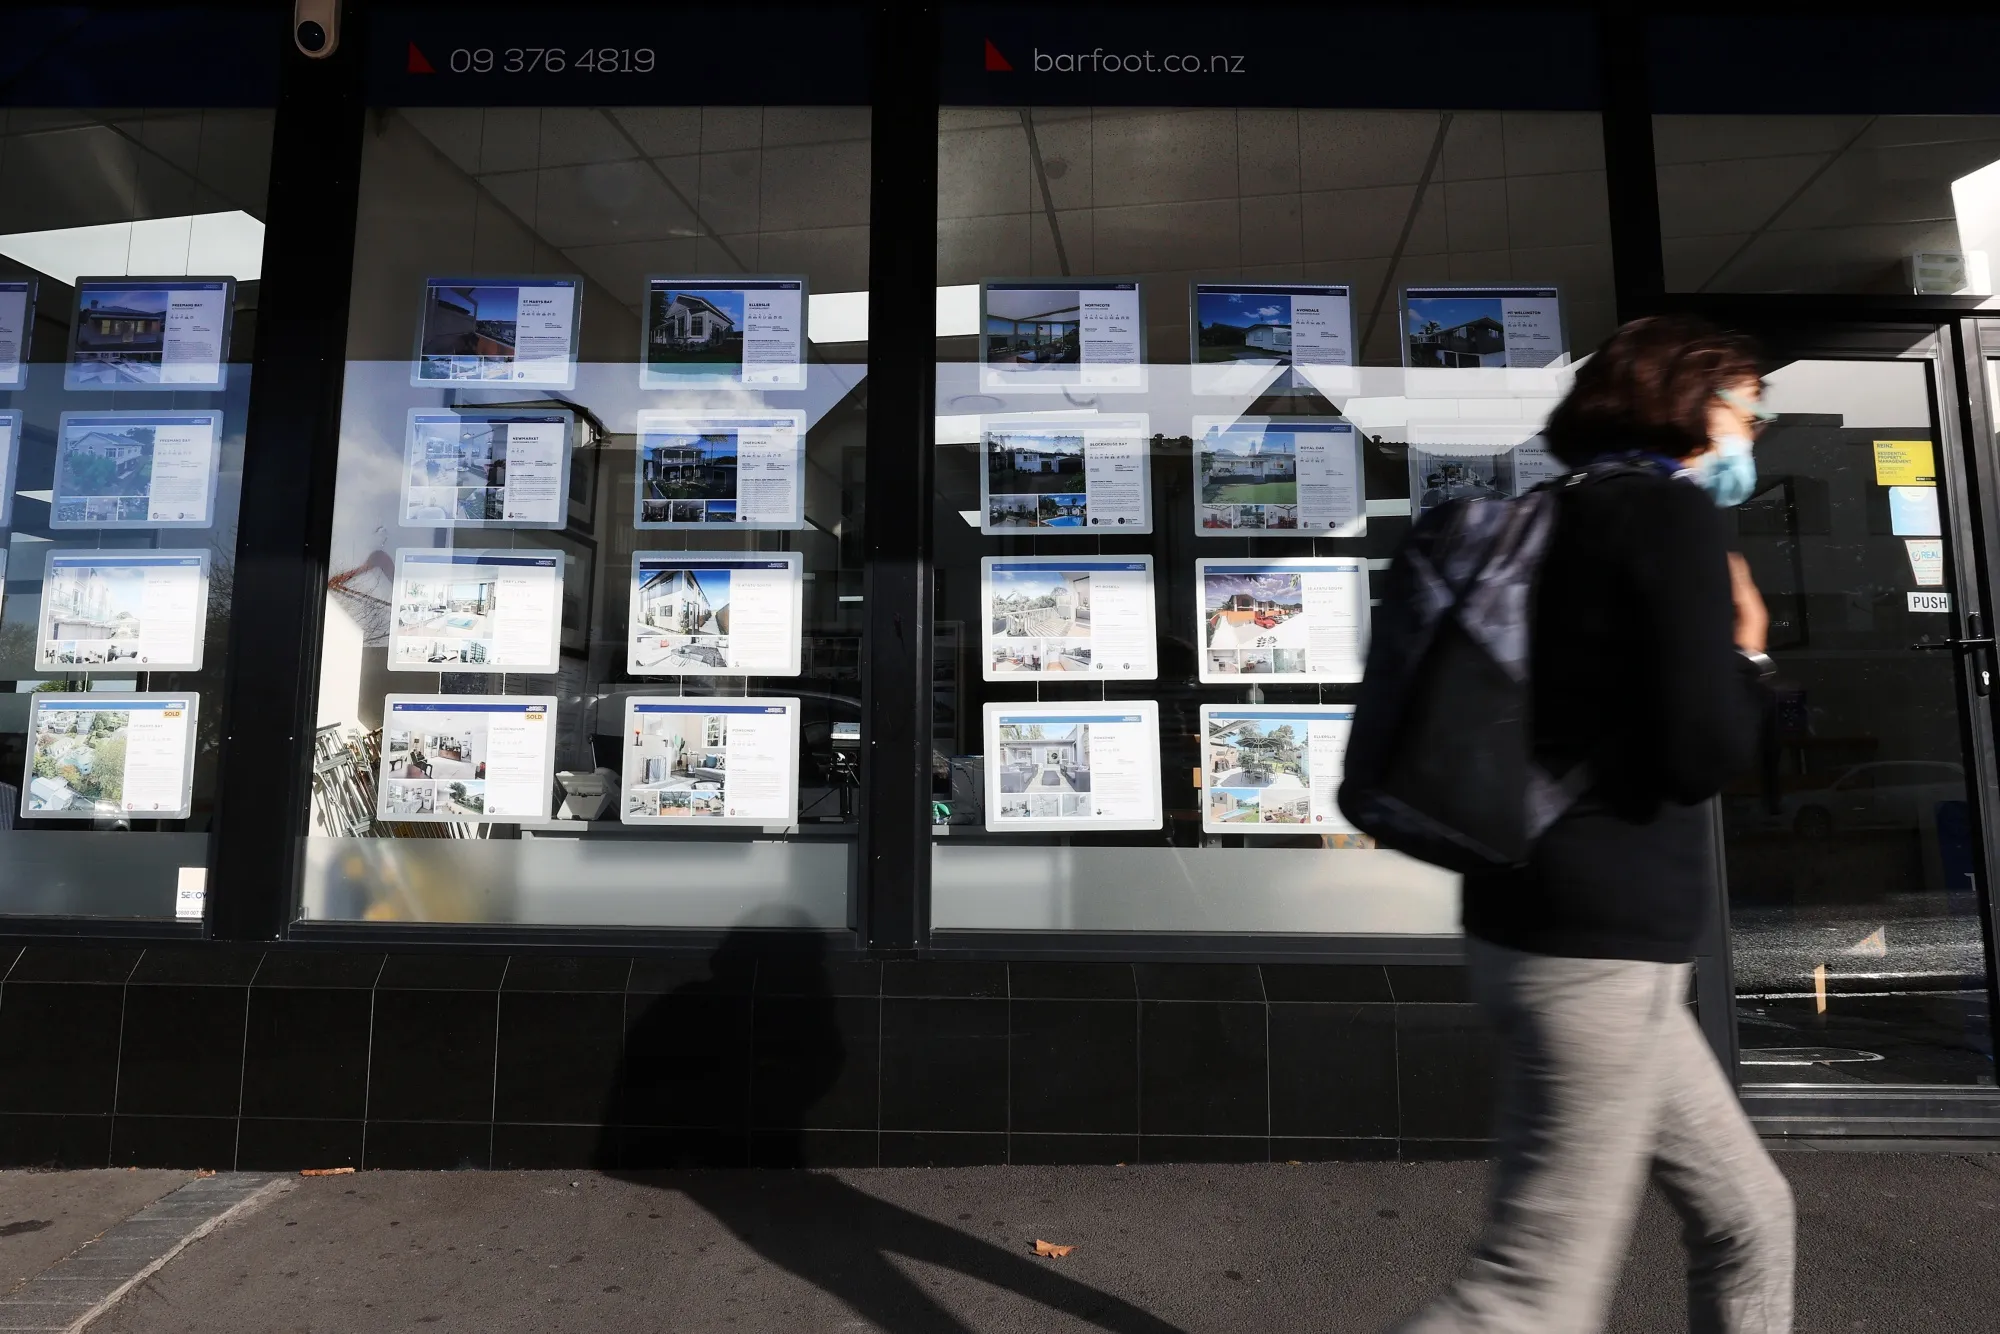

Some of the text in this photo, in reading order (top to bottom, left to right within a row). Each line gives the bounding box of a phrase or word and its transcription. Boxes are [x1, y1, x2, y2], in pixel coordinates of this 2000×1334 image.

[450, 48, 655, 73] 09 376 4819
[1034, 47, 1246, 73] barfoot.co.nz
[1913, 596, 1948, 609] PUSH
